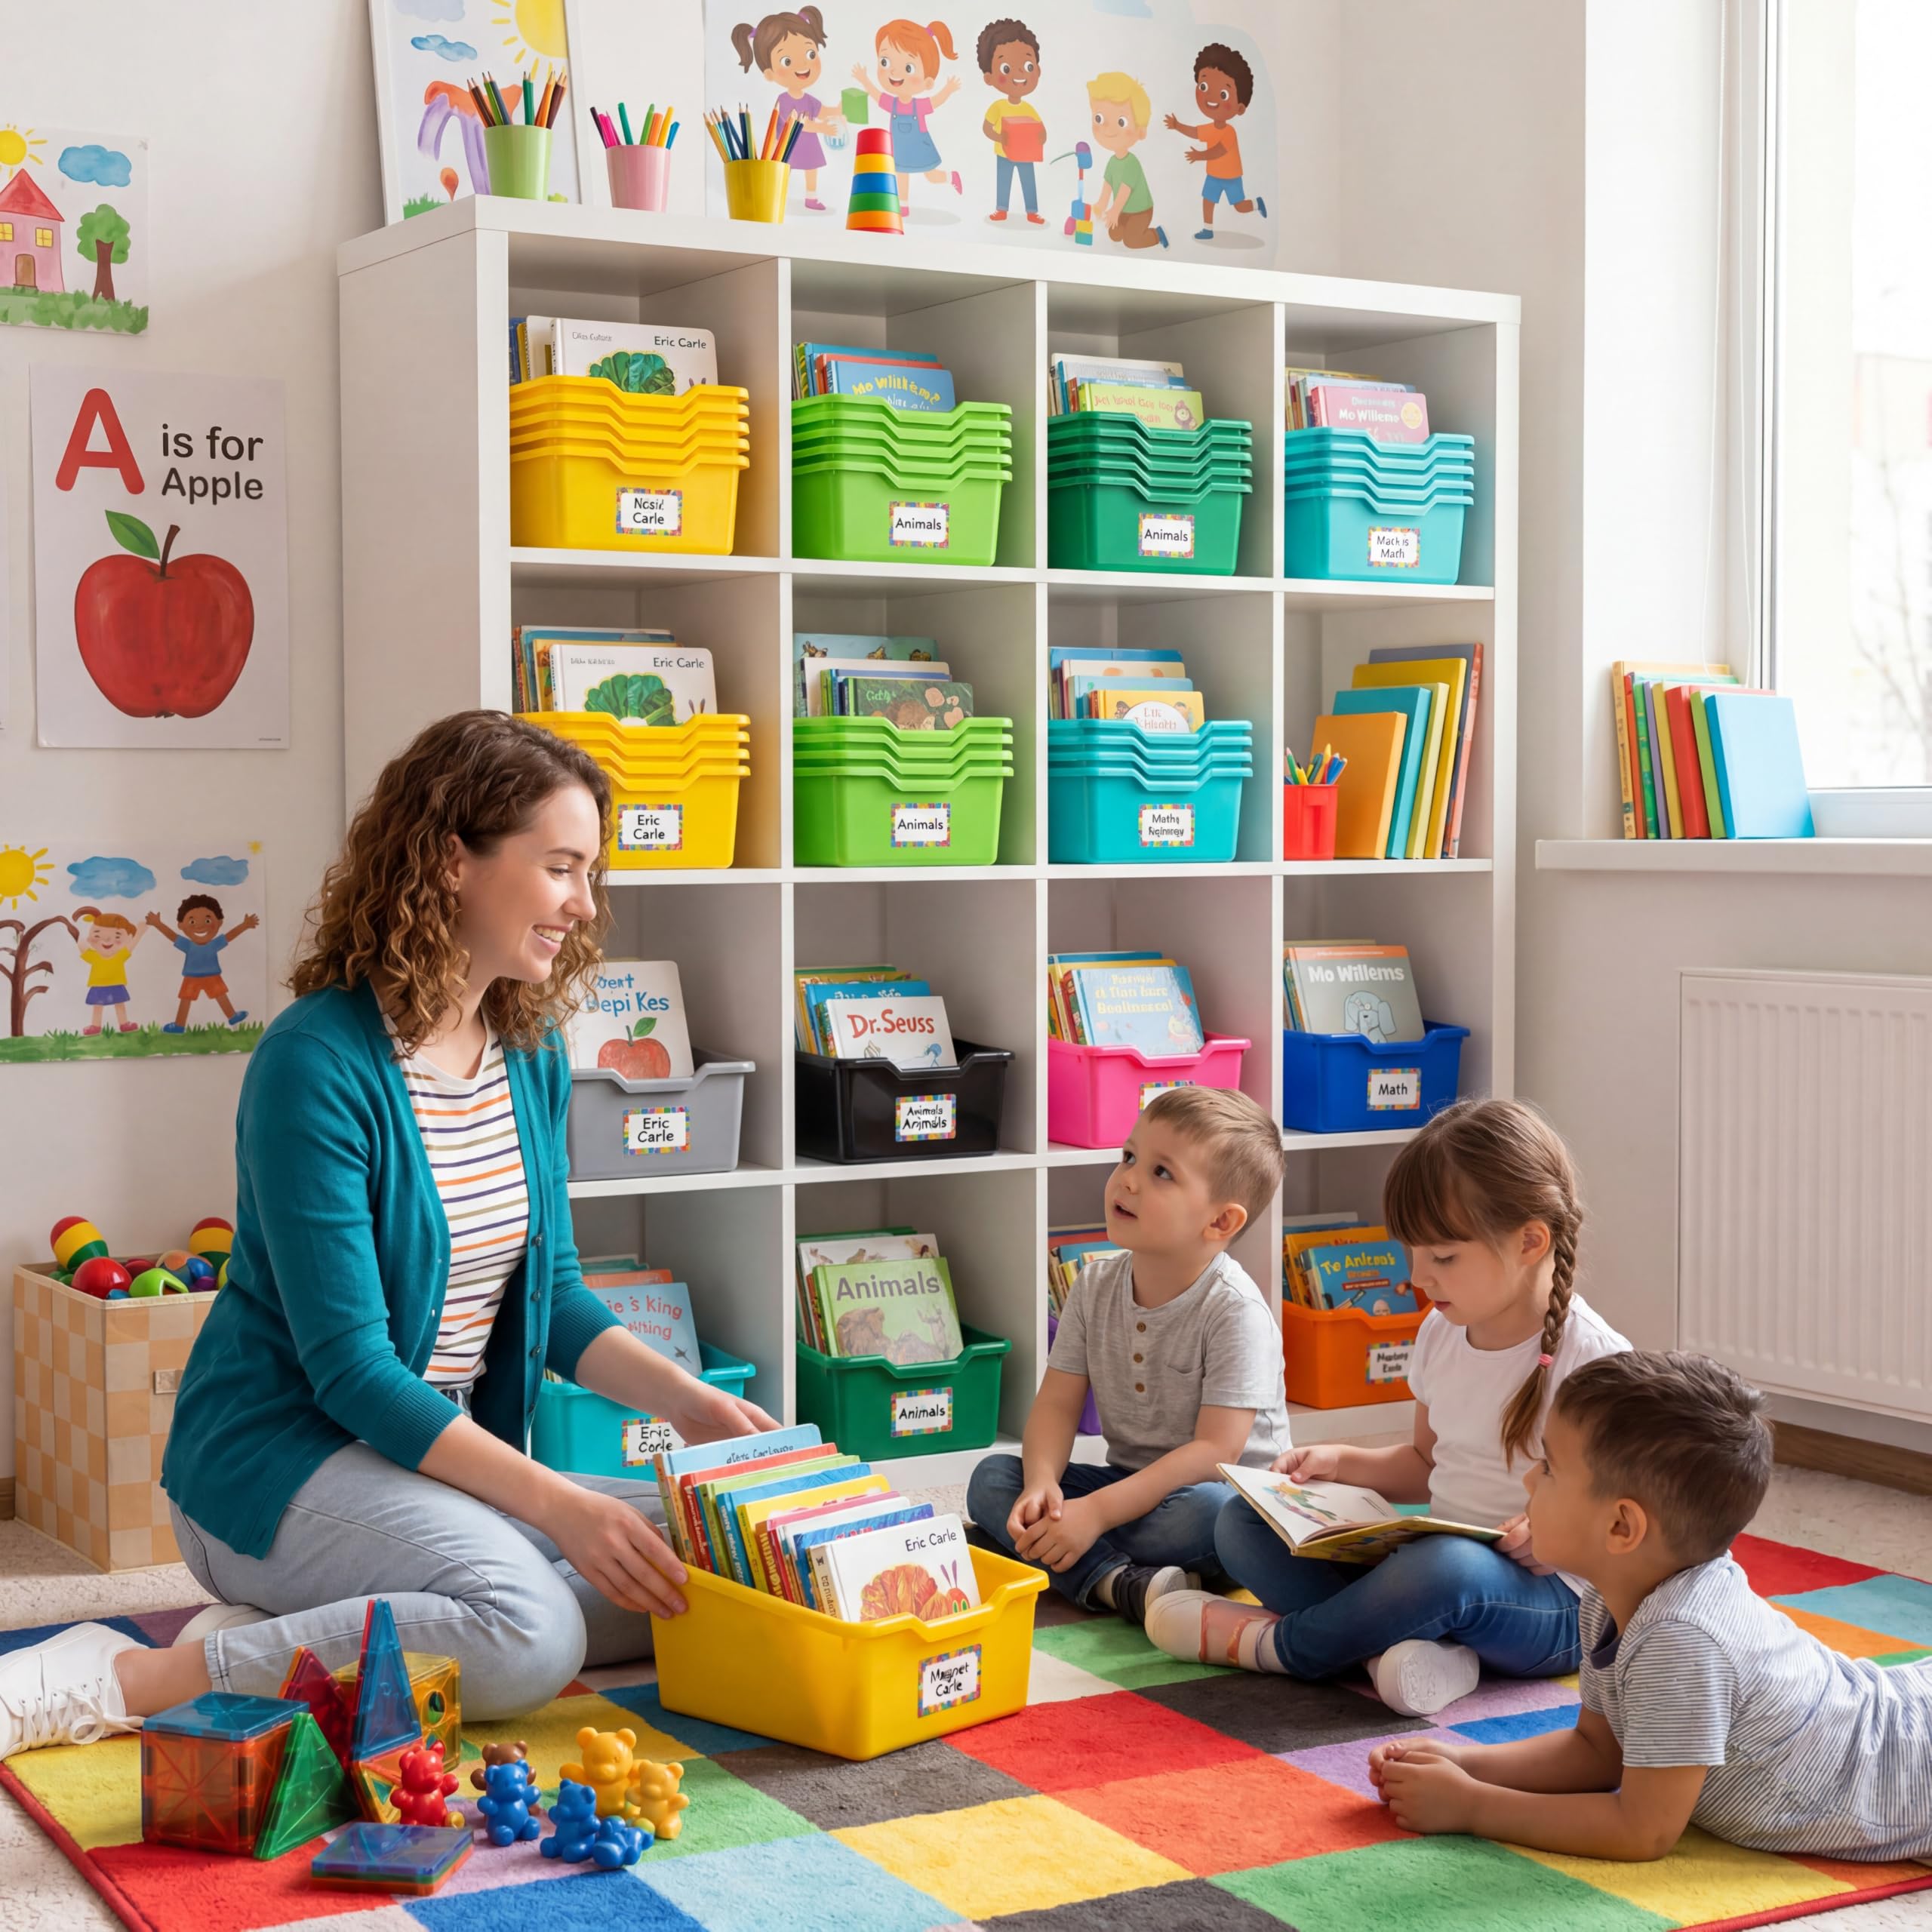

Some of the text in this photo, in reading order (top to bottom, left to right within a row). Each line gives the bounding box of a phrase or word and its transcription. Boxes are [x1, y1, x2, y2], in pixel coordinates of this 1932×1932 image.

[654, 336, 706, 349] Eric Carle
[55, 388, 145, 494] A
[162, 423, 263, 461] is for
[162, 467, 264, 505] Apple
[632, 512, 665, 525] Carle
[895, 518, 941, 531] Animals
[1144, 529, 1189, 542] Animals
[653, 657, 705, 669] Eric Carle
[637, 814, 660, 826] Eric
[897, 818, 943, 830] Animals
[633, 829, 665, 840] Carle
[1308, 964, 1404, 983] Mo Willems
[635, 992, 669, 1011] Kes
[1378, 1083, 1408, 1095] Math
[642, 1117, 669, 1130] Eric
[637, 1131, 674, 1143] Carle
[836, 1271, 941, 1301] Animals
[898, 1404, 946, 1420] Animals
[641, 1426, 670, 1439] Eric
[905, 1528, 958, 1552] Eric Carle
[936, 1678, 963, 1697] Carle
